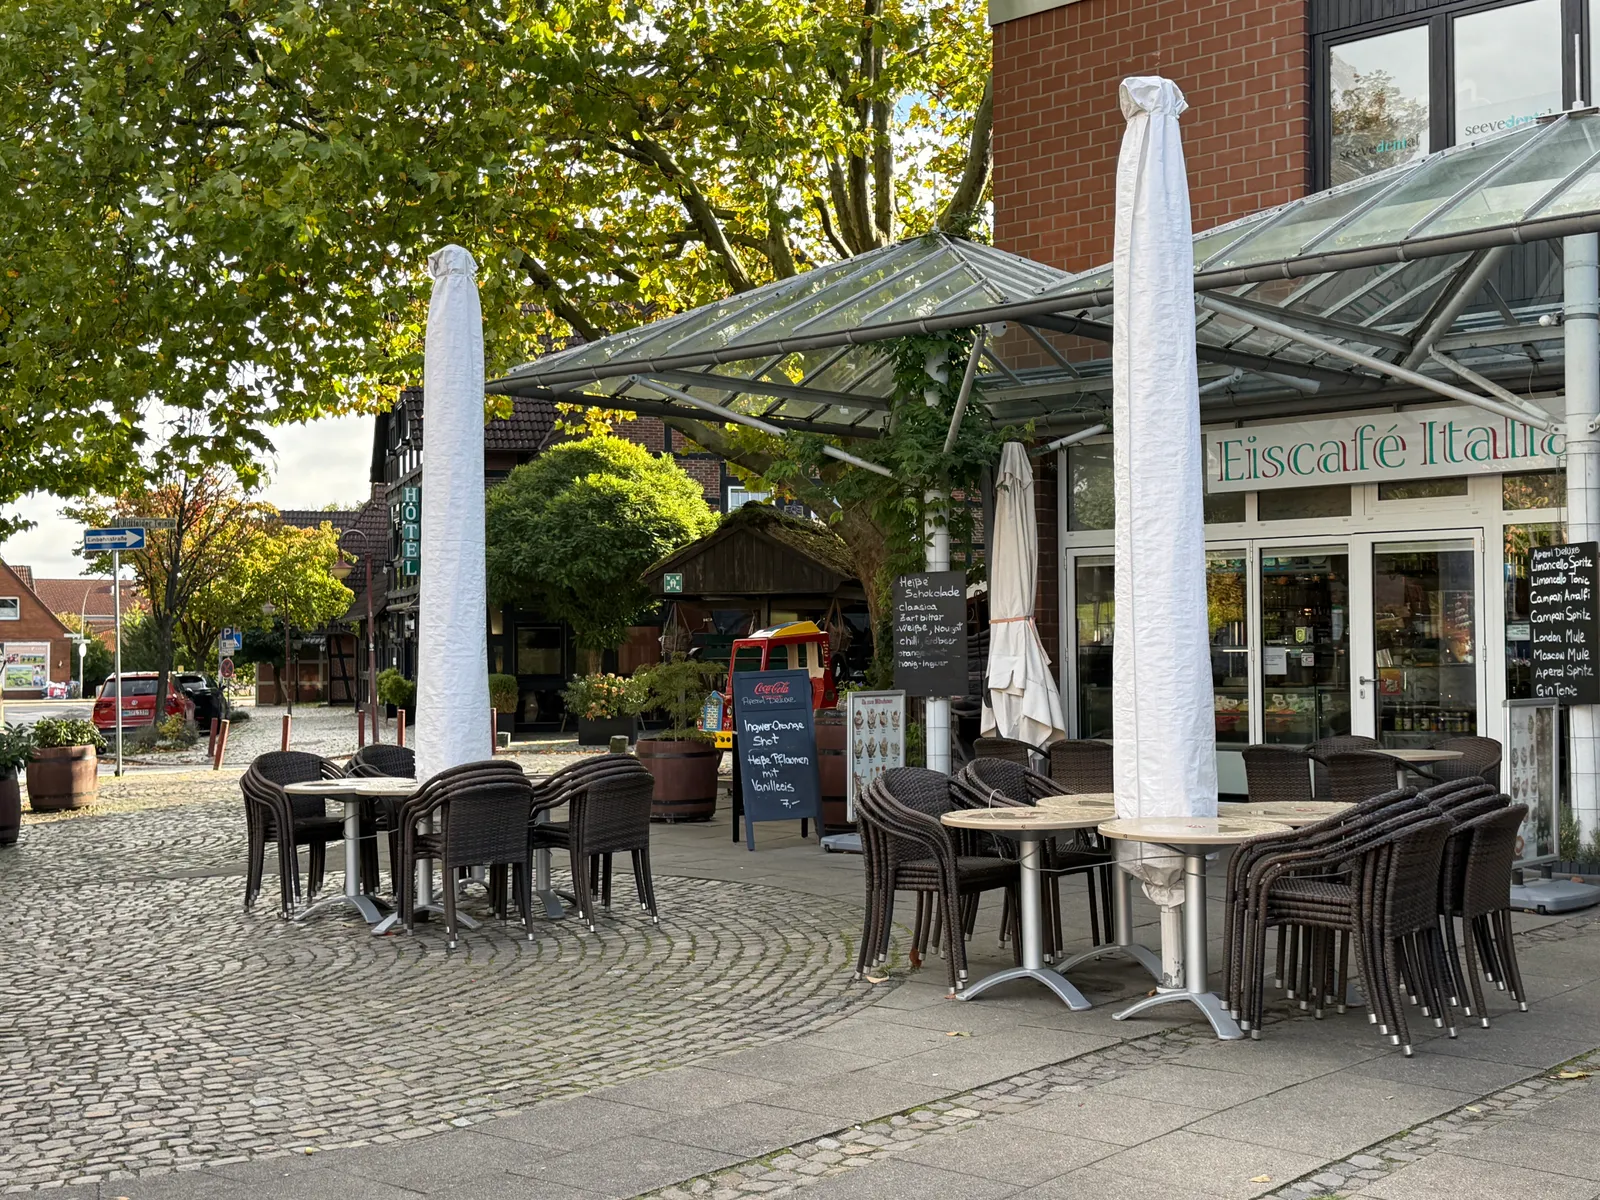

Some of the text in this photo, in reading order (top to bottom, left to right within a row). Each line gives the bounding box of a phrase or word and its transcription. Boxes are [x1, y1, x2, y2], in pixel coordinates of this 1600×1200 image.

[1464, 108, 1553, 137] seevedent
[1339, 132, 1421, 160] seevedental
[1217, 423, 1407, 483] Eiscafé
[87, 535, 128, 543] Einbahnstraße
[404, 487, 418, 576] HOTEL
[1555, 546, 1580, 558] Deluxe
[1530, 555, 1593, 573] Limoncello Spritz
[1530, 572, 1590, 587] Limoncello Tonic
[905, 585, 960, 599] Schokolade
[1530, 588, 1590, 605] Campari Amalfi
[1530, 606, 1591, 624] Campari Spritz
[224, 627, 232, 639] P
[1533, 629, 1562, 643] London
[1565, 628, 1586, 643] Mule
[1533, 648, 1590, 662] Moscow Mule
[1535, 664, 1594, 680] Aperol Spritz
[754, 681, 790, 695] Coca-Cola
[1535, 682, 1578, 697] Gin Tonic
[753, 733, 779, 746] Shot
[747, 752, 809, 768] Heiße Pflaumen
[762, 768, 779, 778] mit
[751, 779, 795, 792] Vanilleeis
